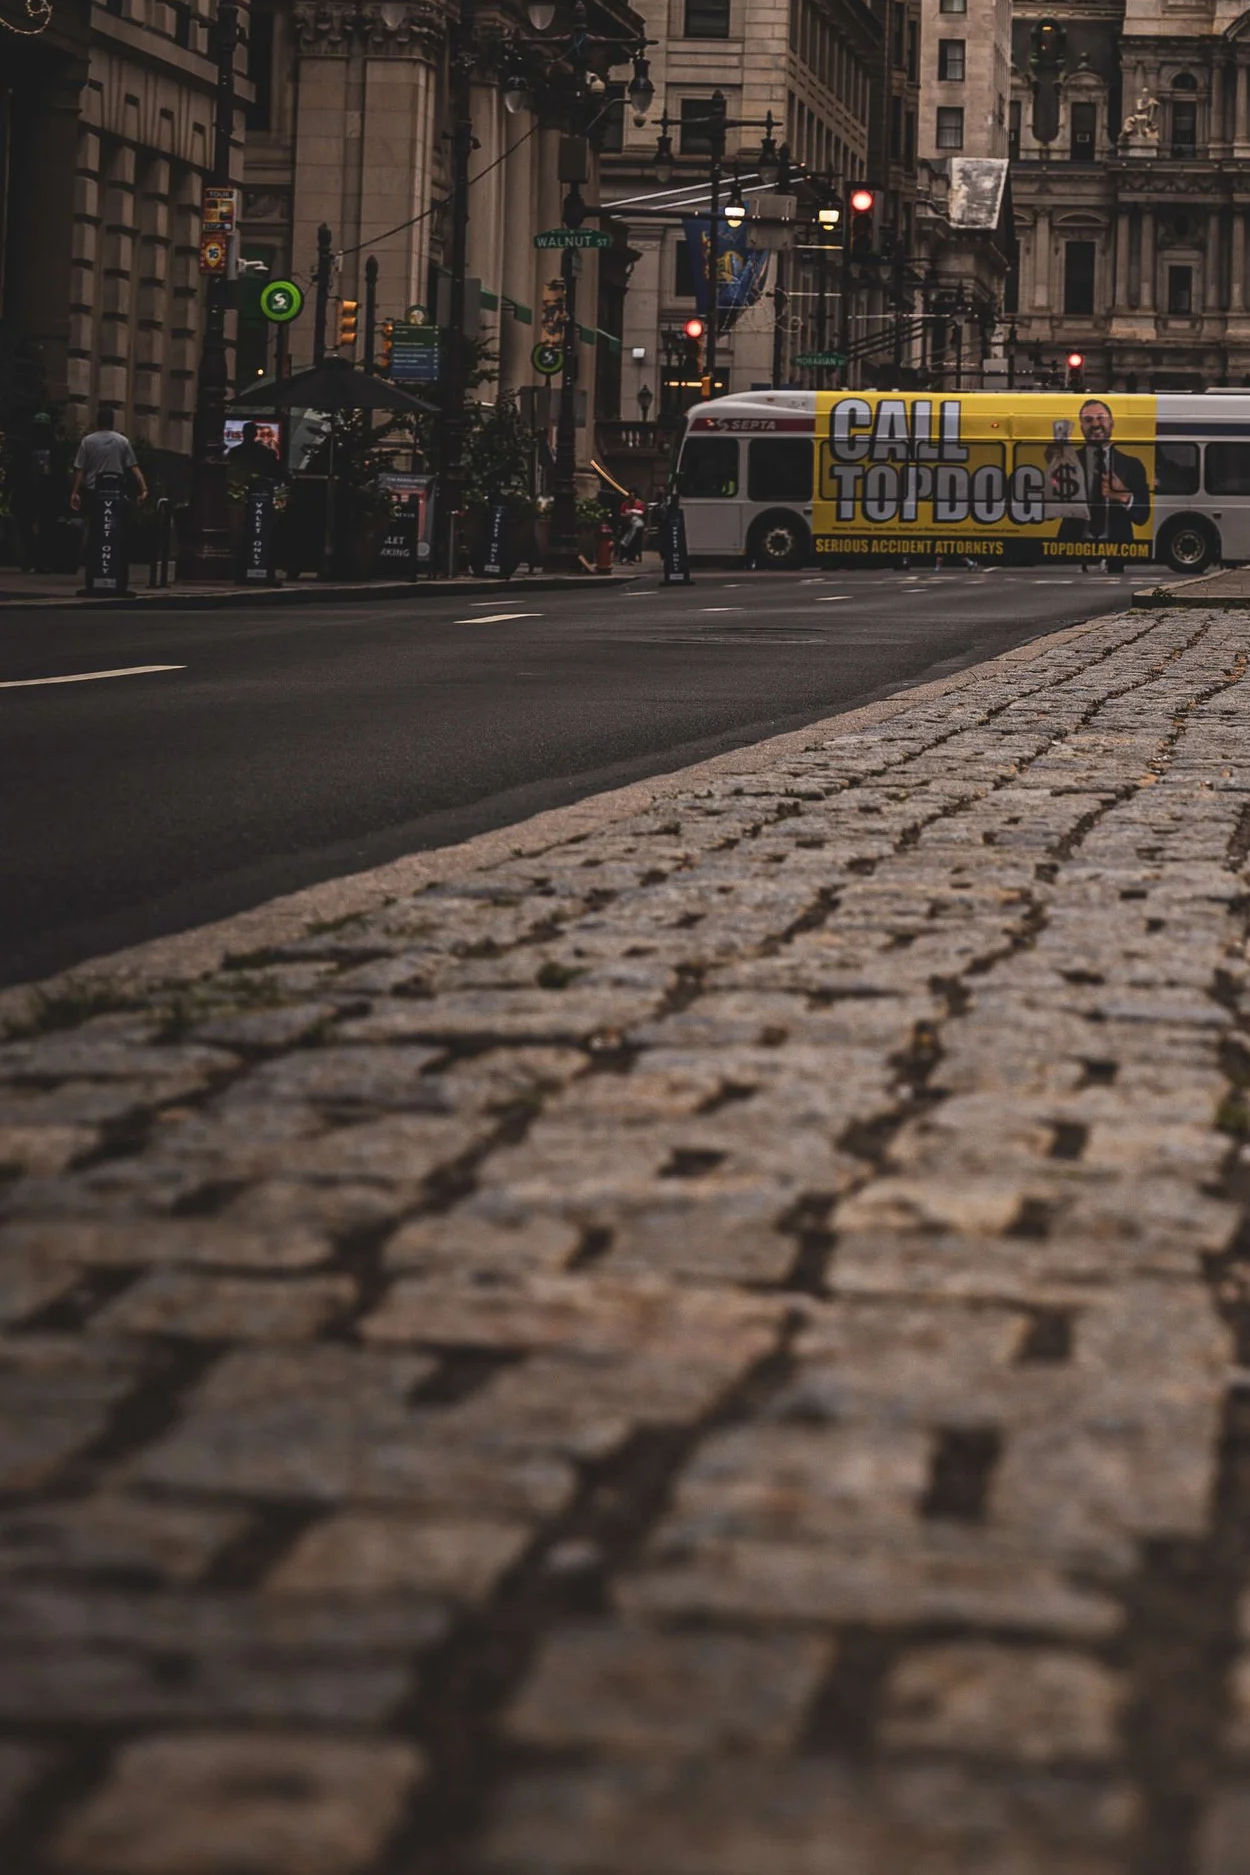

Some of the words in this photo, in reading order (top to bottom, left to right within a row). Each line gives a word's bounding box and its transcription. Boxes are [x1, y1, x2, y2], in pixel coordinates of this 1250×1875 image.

[536, 236, 592, 247] WALNUT
[596, 238, 608, 246] ST
[731, 420, 776, 430] SEPTA
[829, 397, 969, 463] CALL
[830, 463, 1046, 524] TOPDOG
[103, 500, 113, 538] VALET
[254, 501, 264, 534] VALET
[101, 545, 112, 574] ONLY
[252, 540, 263, 566] ONLY
[815, 538, 869, 553] SERIOUS
[871, 539, 932, 554] ACCIDENT
[934, 540, 1004, 555] ATTORNEYS
[1042, 541, 1149, 557] TOPDOGLAW.COM
